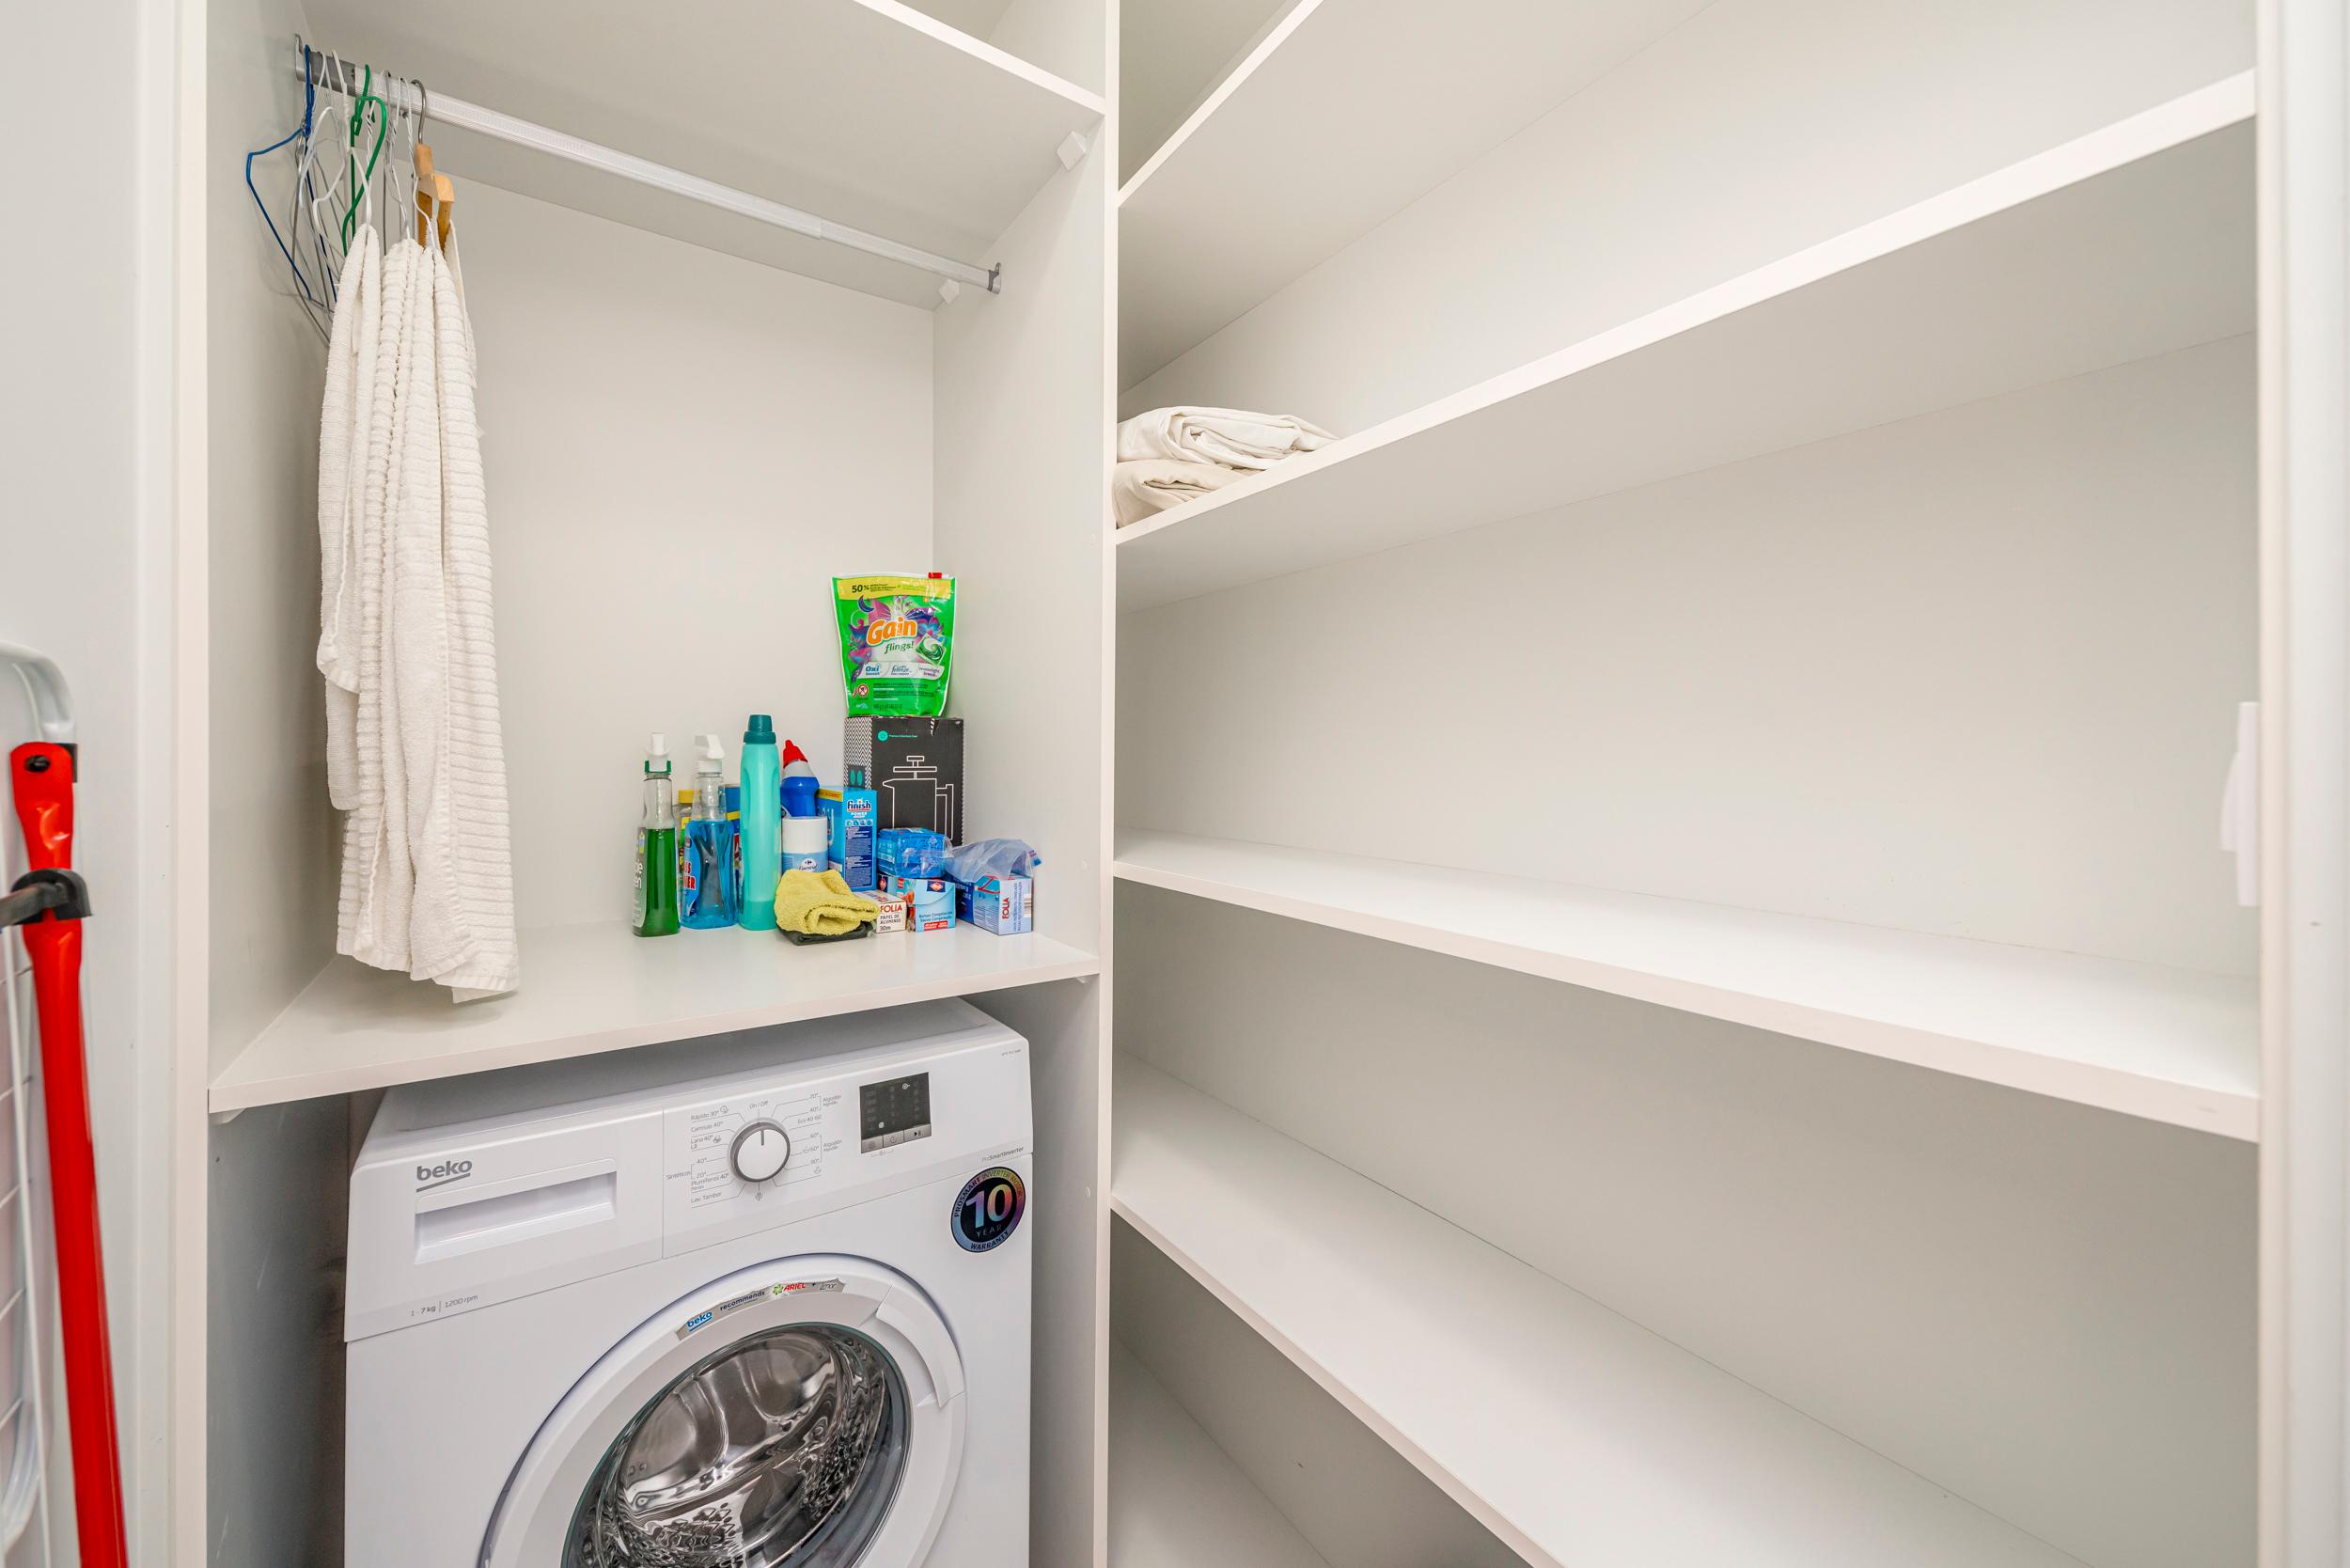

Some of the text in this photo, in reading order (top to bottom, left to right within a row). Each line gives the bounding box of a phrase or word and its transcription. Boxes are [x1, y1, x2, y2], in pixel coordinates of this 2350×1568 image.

[852, 585, 870, 593] 50%
[867, 617, 917, 646] Gain
[884, 642, 914, 654] flings!
[848, 800, 871, 809] finish
[880, 904, 902, 913] FOLIA
[1001, 897, 1010, 919] FOLIA
[416, 1160, 473, 1182] beko
[954, 1176, 981, 1218] PROSMART
[981, 1169, 1010, 1180] INVERTER
[965, 1184, 1013, 1229] 10
[970, 1230, 1010, 1250] WARRANTY
[976, 1224, 1002, 1238] YEAR
[445, 1297, 463, 1309] 1200
[464, 1294, 478, 1304] rpm
[686, 1311, 713, 1327] beko
[720, 1291, 765, 1311] recommends
[783, 1282, 806, 1292] ARIEL
